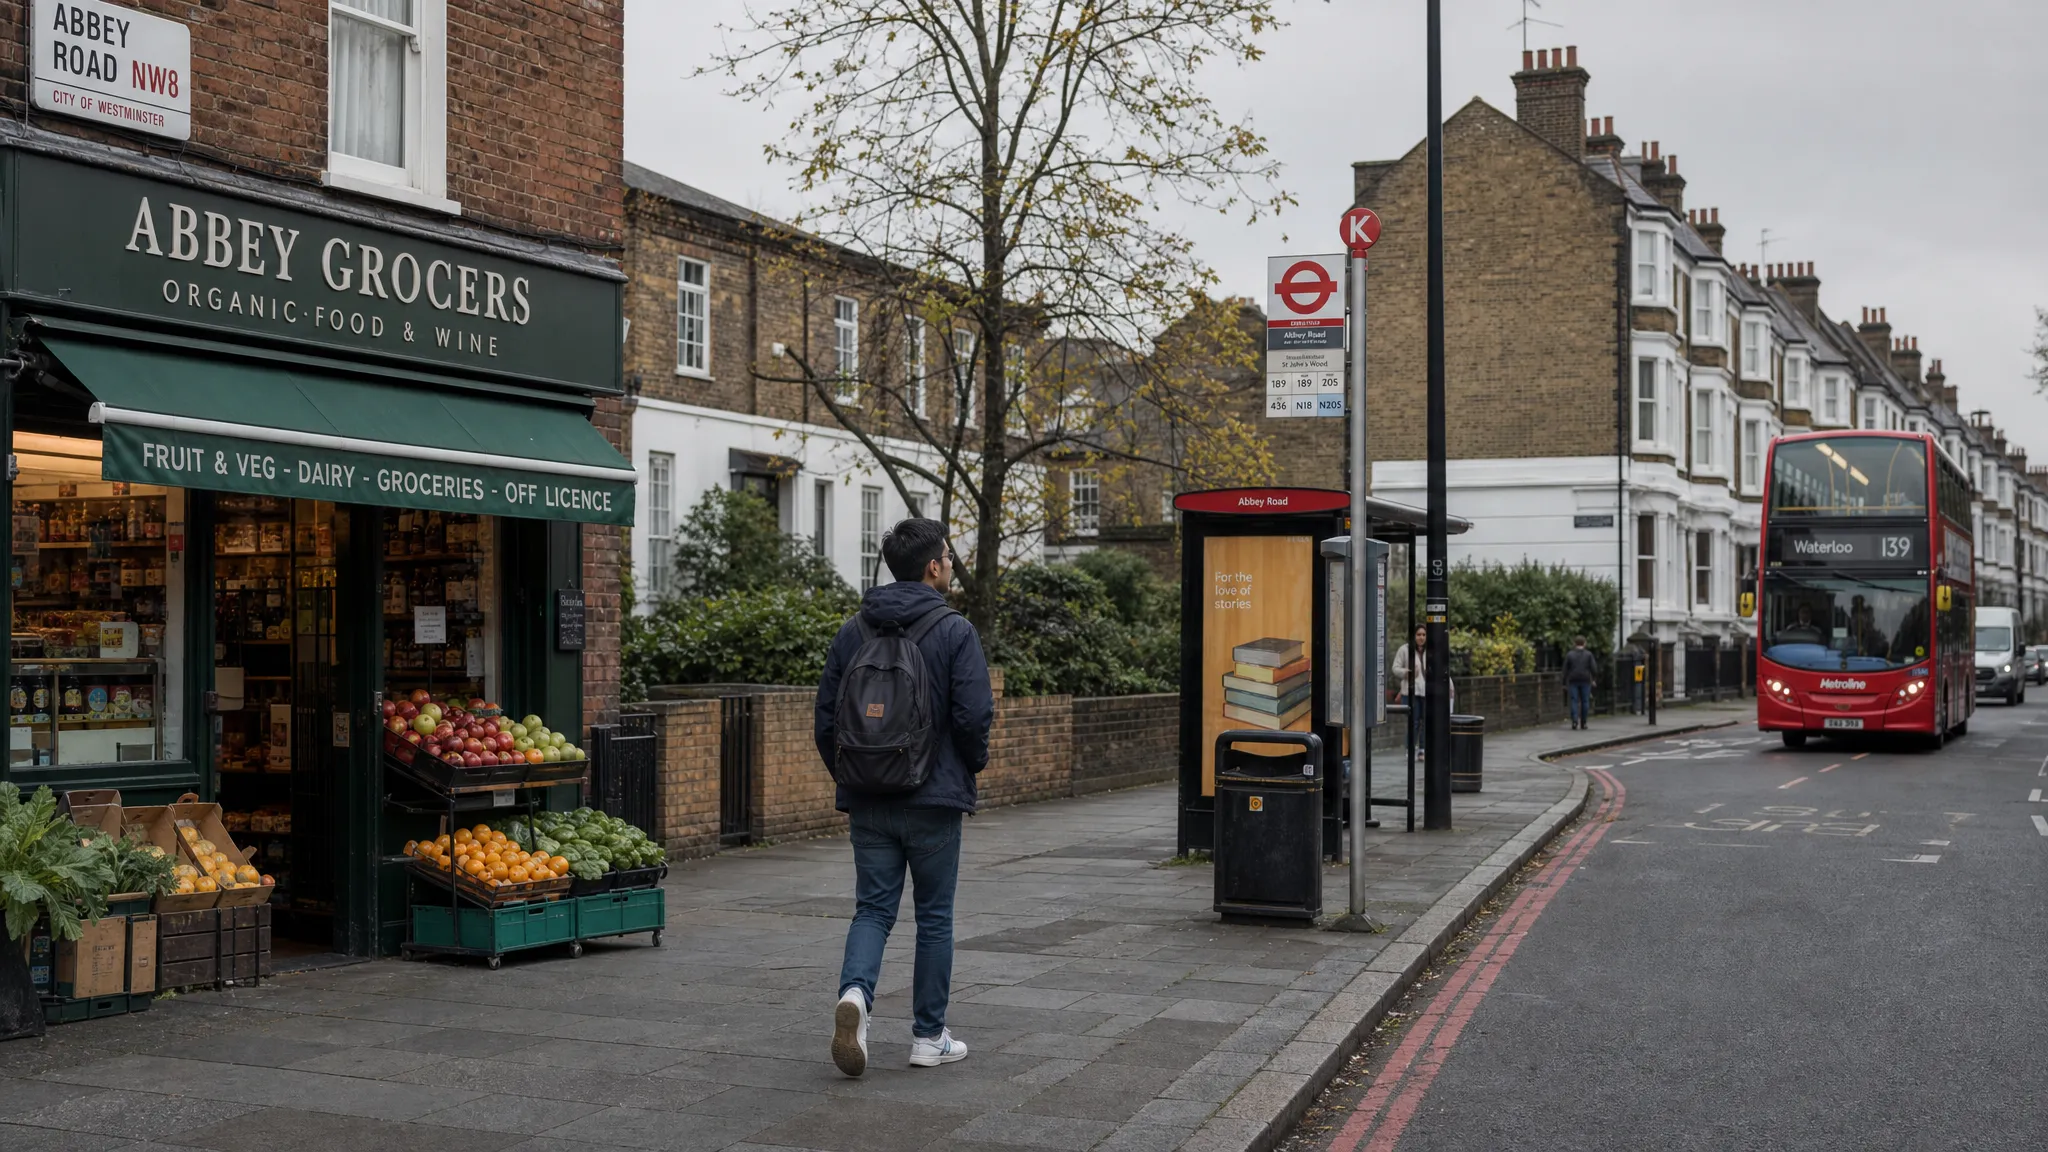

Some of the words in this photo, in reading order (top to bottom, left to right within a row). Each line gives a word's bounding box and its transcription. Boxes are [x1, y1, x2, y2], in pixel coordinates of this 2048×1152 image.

[53, 3, 130, 48] ABBEY
[54, 41, 117, 82] ROAD
[132, 60, 179, 98] NW8
[53, 90, 75, 106] CITY
[81, 96, 93, 111] OF
[98, 100, 164, 127] WESTMINSTER
[1350, 215, 1373, 243] K
[125, 196, 299, 281] ABBEY
[321, 237, 531, 325] GROCERS
[403, 322, 414, 342] &
[435, 326, 498, 357] WINE
[1271, 379, 1286, 388] 189
[1297, 379, 1312, 387] 189
[1322, 378, 1338, 386] 205
[1271, 401, 1286, 410] 436
[1319, 400, 1342, 409] N205
[143, 442, 204, 472] FRUIT
[214, 450, 228, 475] &
[236, 452, 276, 480] VEG
[298, 459, 355, 488] DAIRY
[377, 468, 484, 500] GROCERIES
[505, 481, 537, 505] OFF
[545, 486, 612, 512] LICENCE
[1238, 496, 1265, 508] Abbey
[1267, 496, 1288, 506] Road
[1793, 539, 1853, 554] Waterloo
[1881, 536, 1911, 558] 139
[1215, 571, 1232, 582] For
[1235, 571, 1253, 582] the
[1215, 585, 1237, 596] love
[1240, 585, 1251, 596] of
[1214, 598, 1252, 609] stories
[1820, 678, 1866, 690] Metroline
